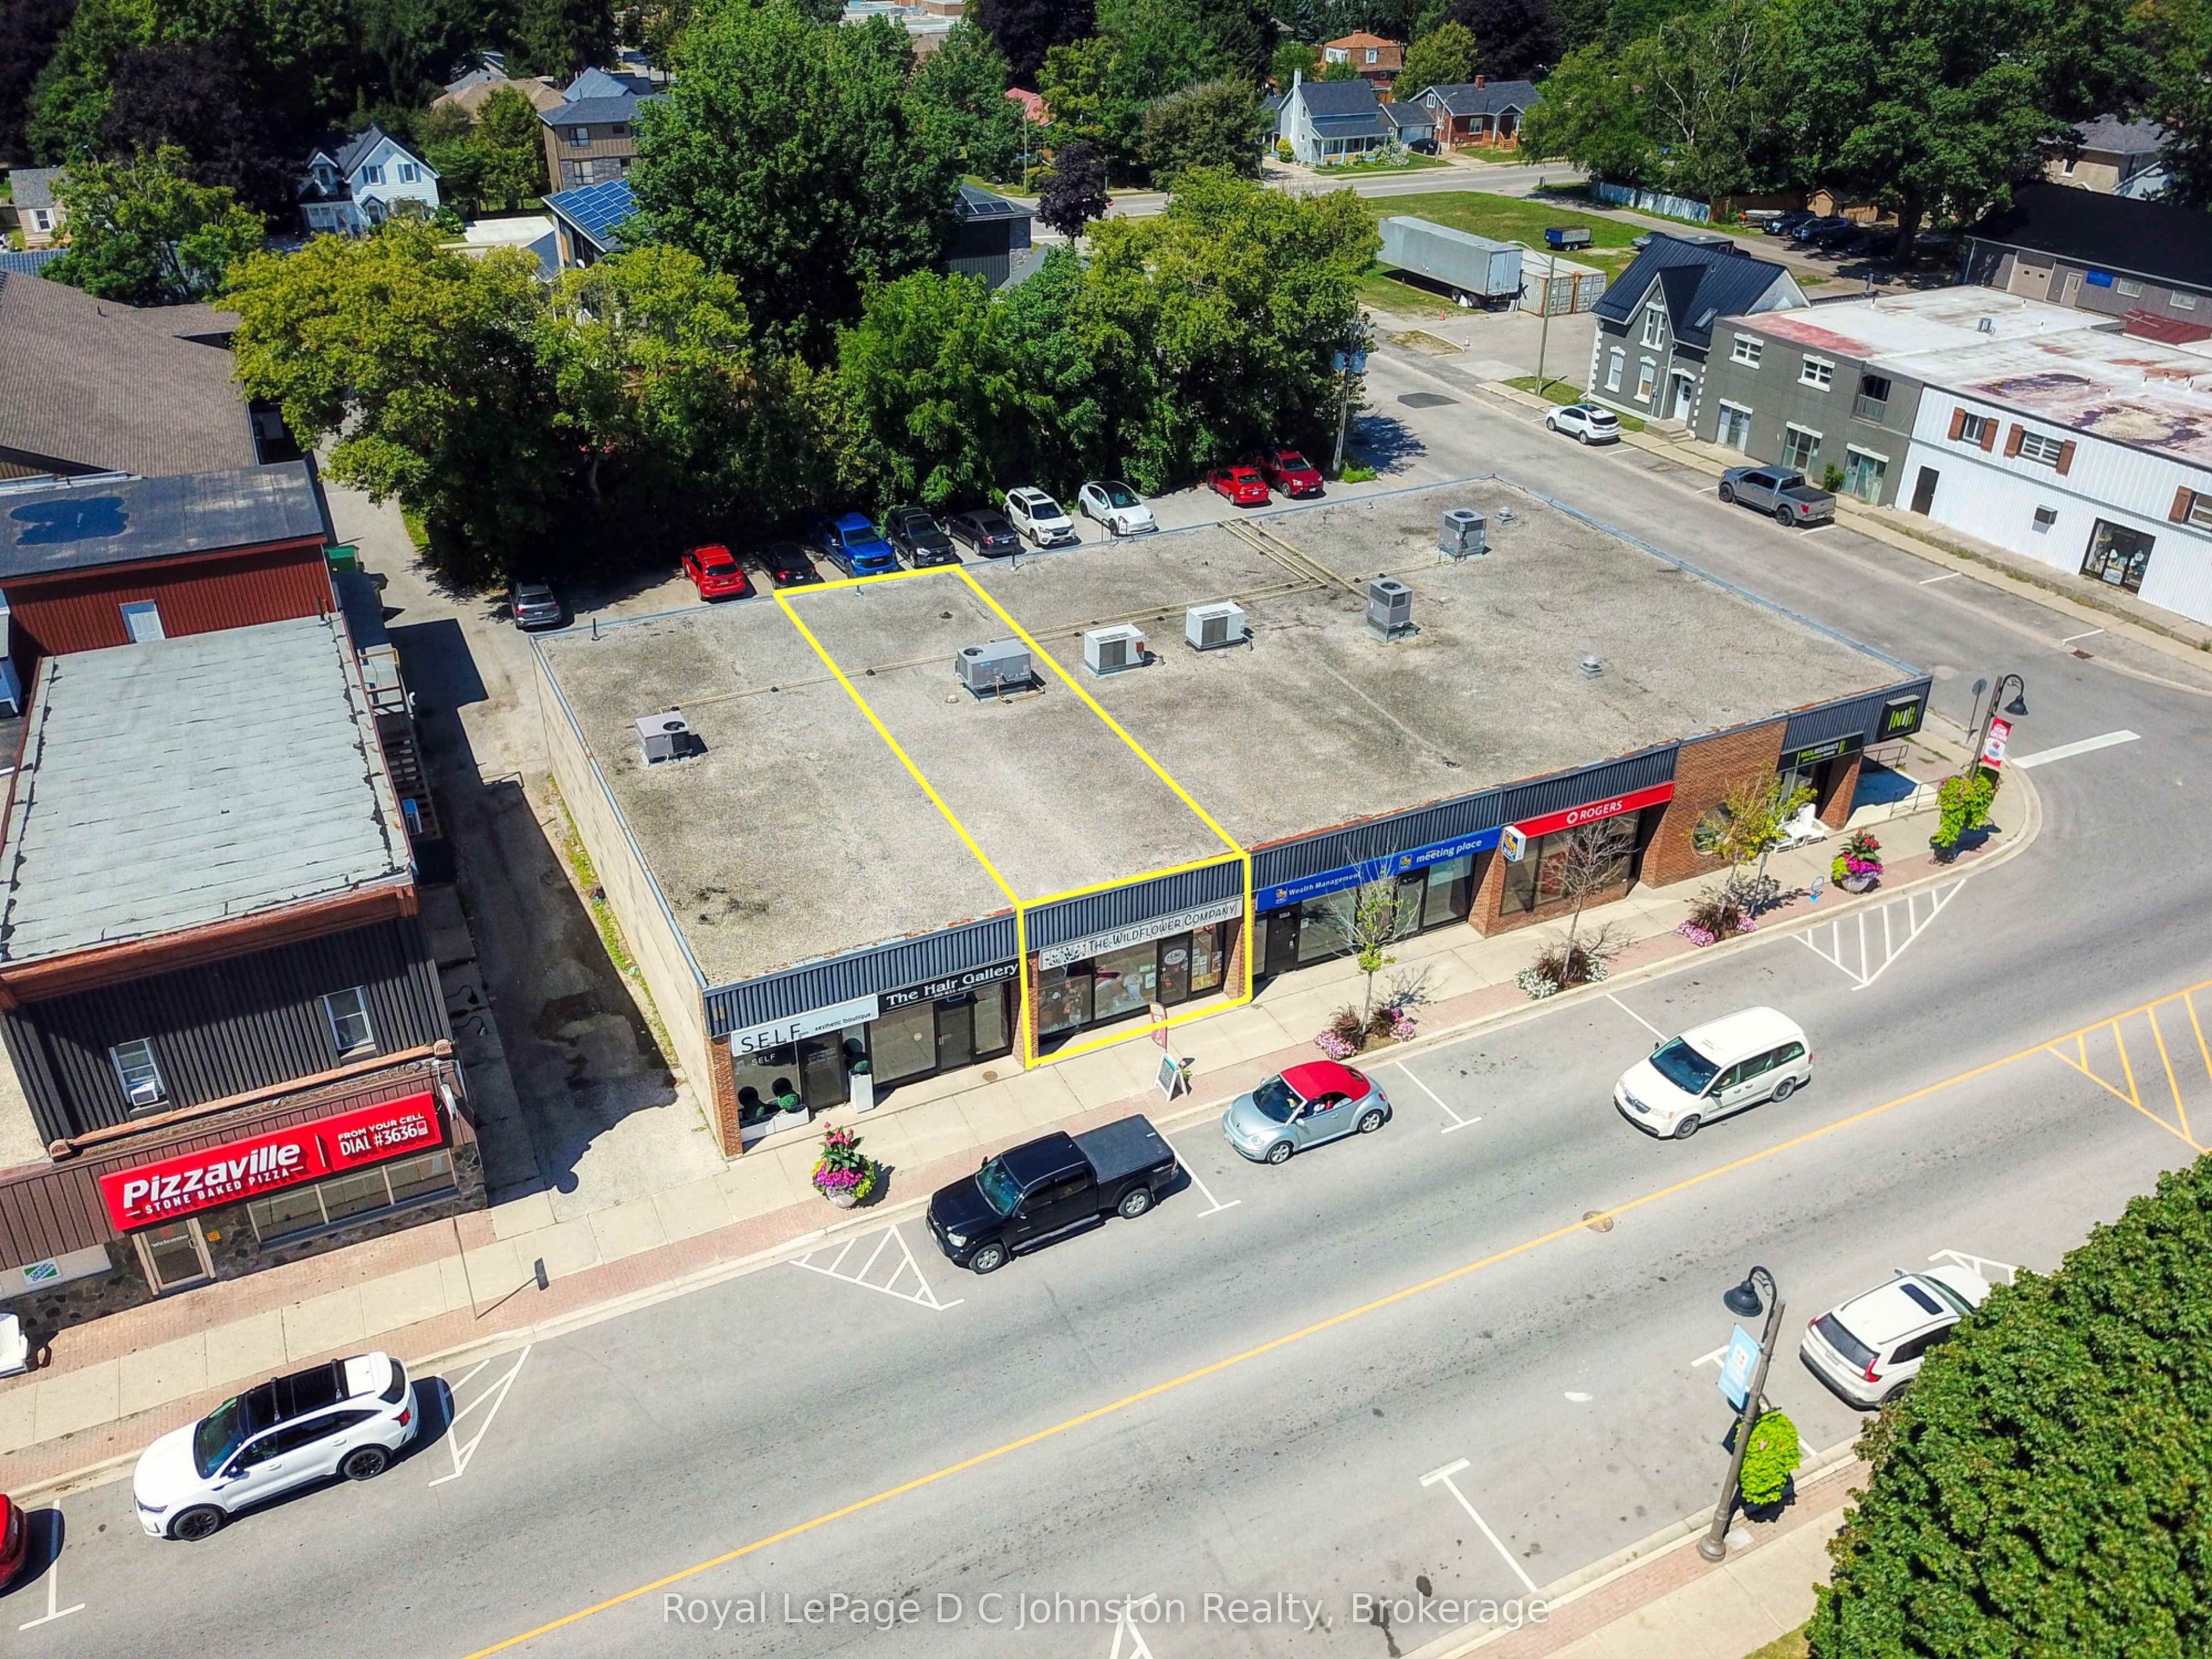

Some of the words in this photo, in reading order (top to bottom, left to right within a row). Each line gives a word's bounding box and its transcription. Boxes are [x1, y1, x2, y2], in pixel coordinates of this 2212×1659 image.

[1580, 800, 1623, 820] ROGERS
[1416, 846, 1455, 863] meeting
[1456, 840, 1482, 855] place
[1289, 884, 1314, 896] Wealth
[1315, 872, 1361, 889] Management
[1088, 939, 1109, 952] THE
[1112, 918, 1181, 945] WILDFLOWER
[1184, 903, 1237, 926] COMPANY
[886, 990, 918, 1006] The
[923, 979, 958, 997] Hair
[962, 963, 1019, 984] Gallery
[741, 1022, 801, 1054] SELF
[814, 1019, 842, 1032] aesthetic
[843, 1012, 872, 1024] boutique
[751, 1053, 776, 1066] SELF
[338, 1127, 367, 1141] FROM
[369, 1119, 398, 1132] YOUR
[399, 1112, 425, 1124] CELL
[339, 1135, 372, 1156] DIAL
[374, 1123, 418, 1147] #3636
[123, 1143, 301, 1210] Pizzaville
[145, 1195, 191, 1215] STONE
[198, 1179, 242, 1200] BAKED
[248, 1166, 290, 1186] PIZZA
